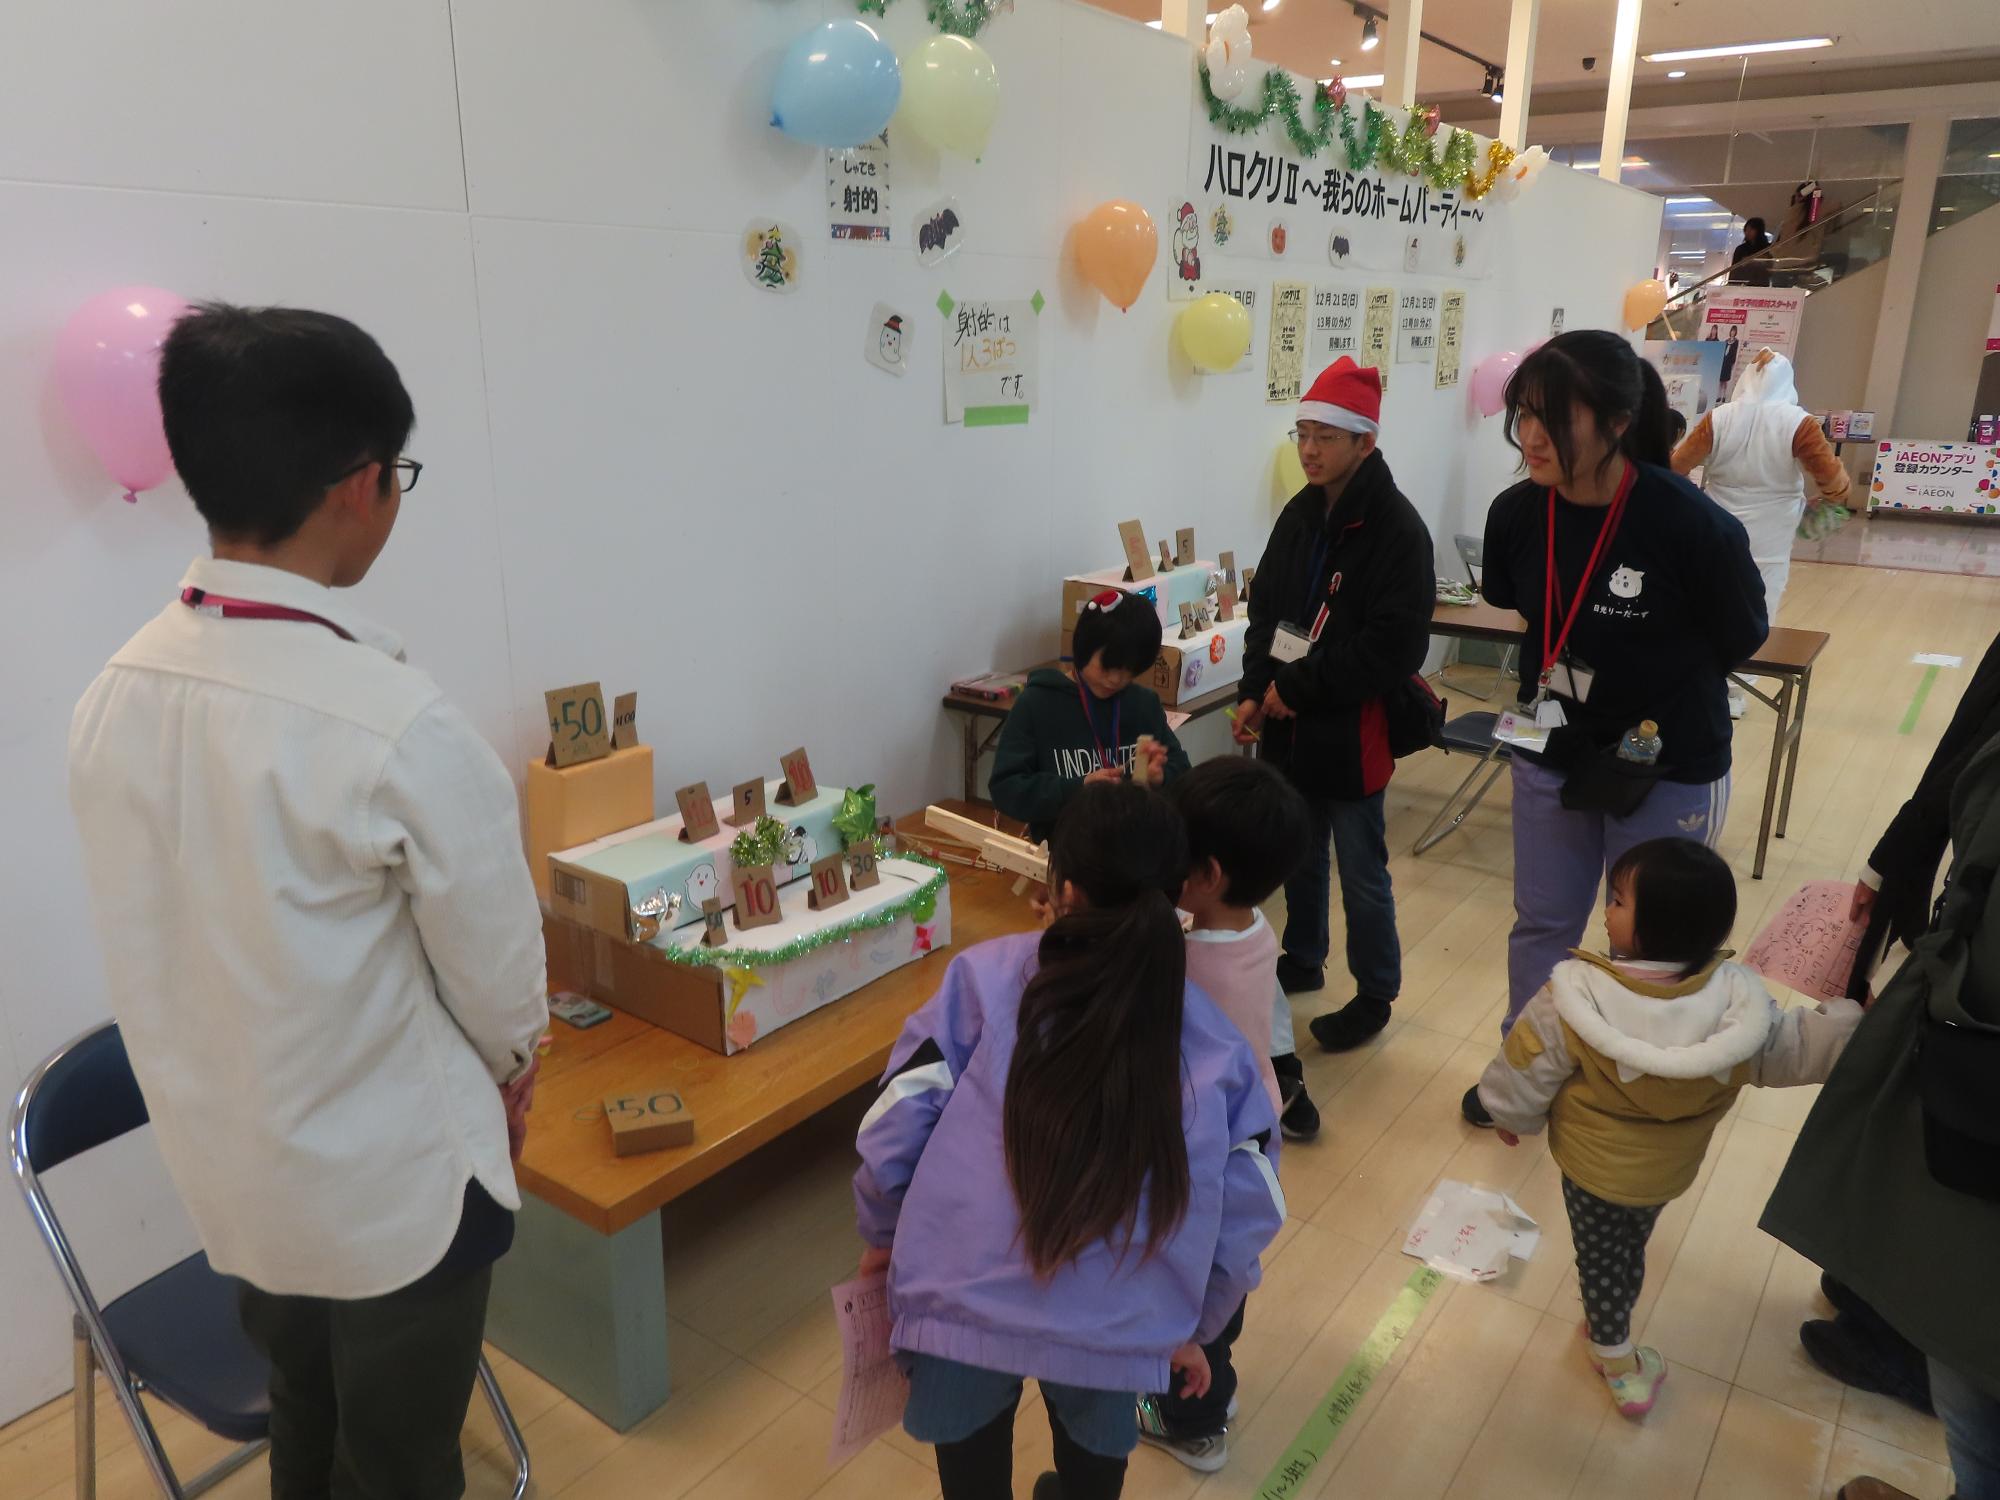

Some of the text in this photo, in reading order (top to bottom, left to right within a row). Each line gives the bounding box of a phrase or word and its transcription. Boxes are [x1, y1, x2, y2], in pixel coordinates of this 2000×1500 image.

[843, 159, 877, 177] しゃてき
[843, 184, 879, 215] 射的
[1315, 292, 1359, 310] 12月21日(日)
[1401, 296, 1436, 311] 12月21日(日)
[953, 303, 1011, 347] 射的は
[1316, 316, 1352, 329] 13時00分より
[1895, 450, 1977, 466] iAEONアプリ
[1893, 462, 1974, 477] 登録カウンター
[1918, 487, 1955, 499] iAEON
[1181, 612, 1194, 630] 25
[550, 697, 602, 741] +50
[744, 788, 753, 806] 5
[851, 852, 874, 877] 30
[815, 867, 839, 899] 10
[740, 876, 777, 918] 10
